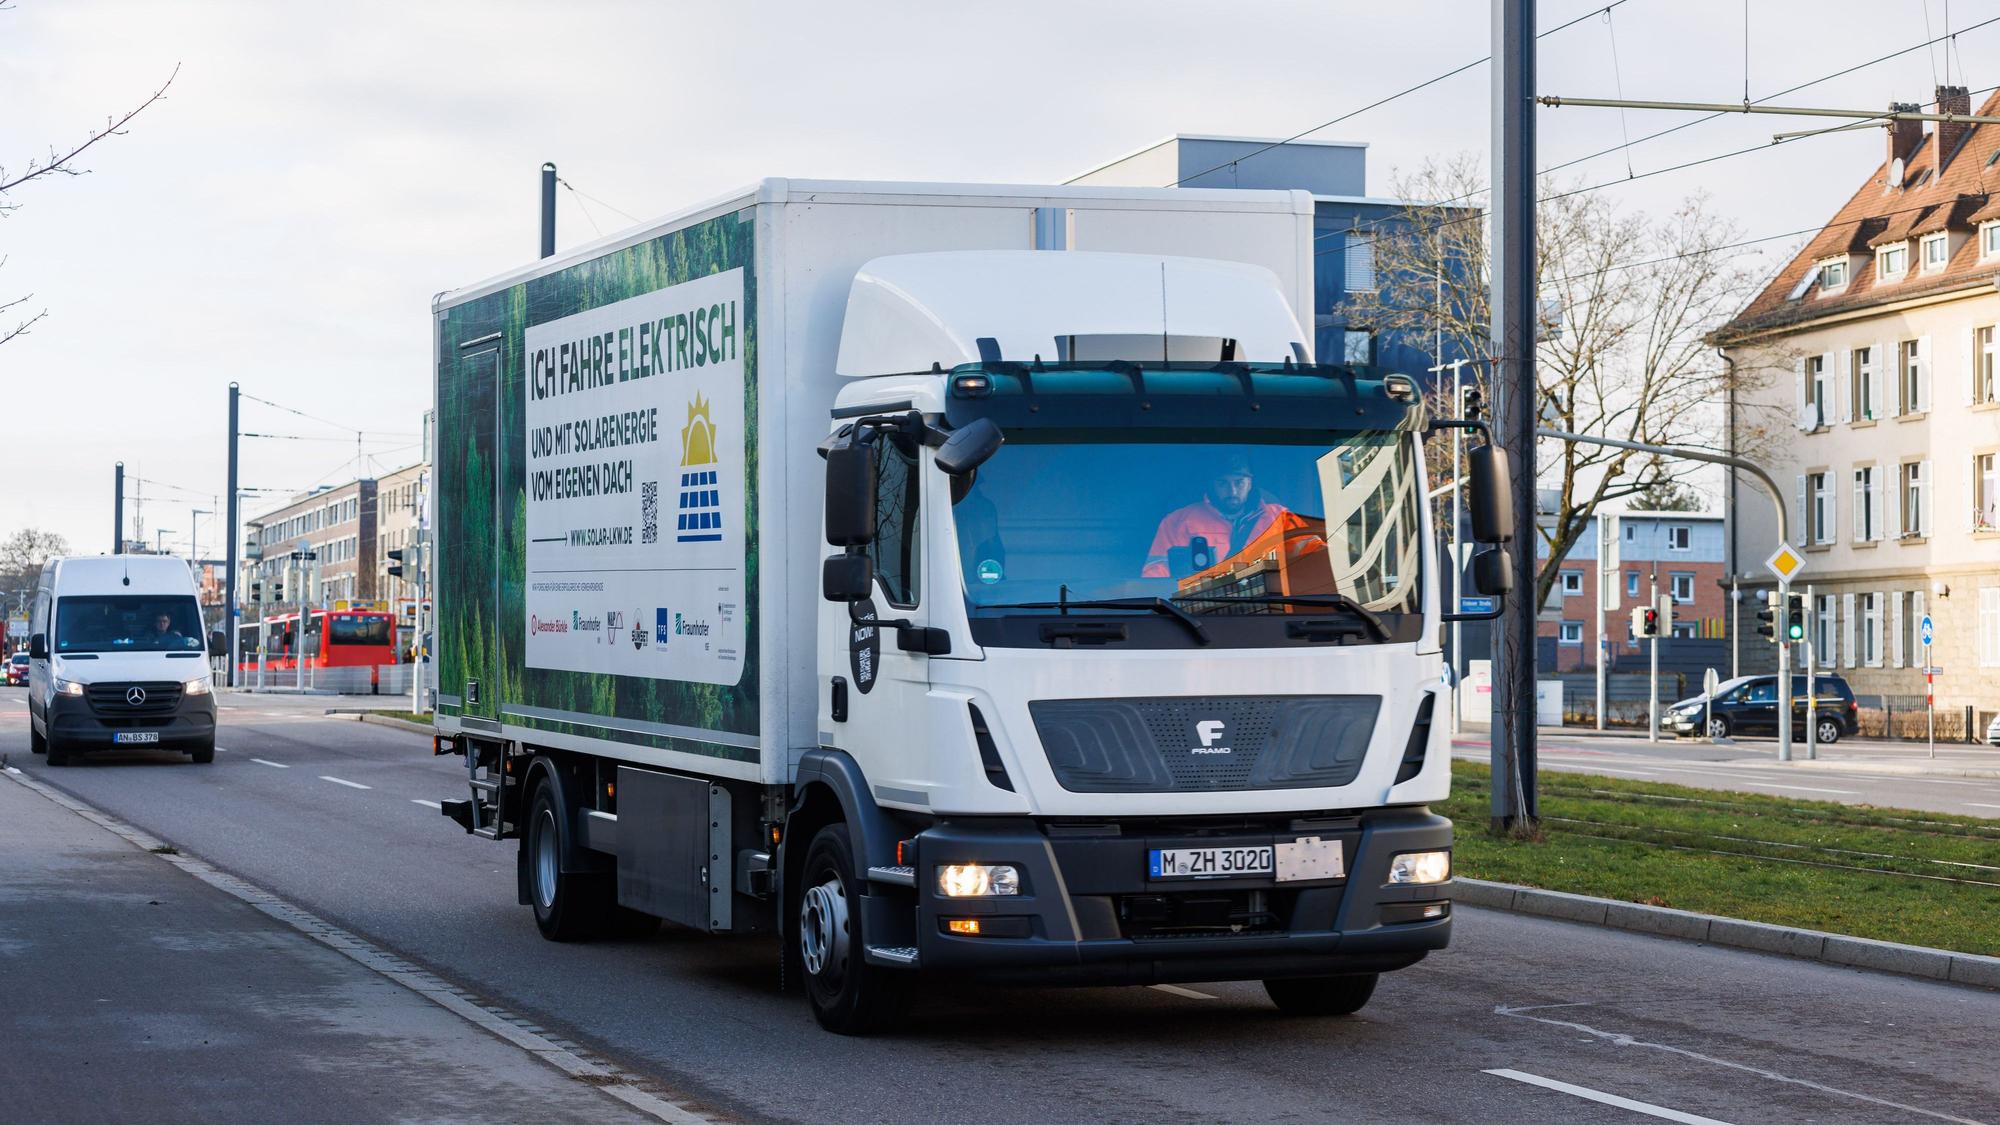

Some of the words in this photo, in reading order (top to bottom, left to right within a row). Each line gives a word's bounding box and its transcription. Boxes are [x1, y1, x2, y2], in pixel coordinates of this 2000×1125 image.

[530, 347, 556, 401] ICH
[560, 331, 614, 395] FAHRE
[618, 300, 736, 383] ELEKTRISCH
[531, 426, 553, 459] UND
[555, 422, 572, 455] MIT
[574, 407, 658, 453] SOLARENERGIE
[531, 470, 553, 502] VOM
[555, 463, 600, 499] EIGENEN
[603, 459, 632, 495] DACH
[570, 526, 633, 547] WWW.SOLAR-LKW.DE
[579, 616, 601, 632] Fraunhofer
[682, 620, 710, 636] Fraunhofer
[1191, 747, 1231, 755] FRAMO
[1163, 852, 1176, 873] M
[1189, 850, 1216, 873] ZH
[1221, 849, 1271, 871] 3020
